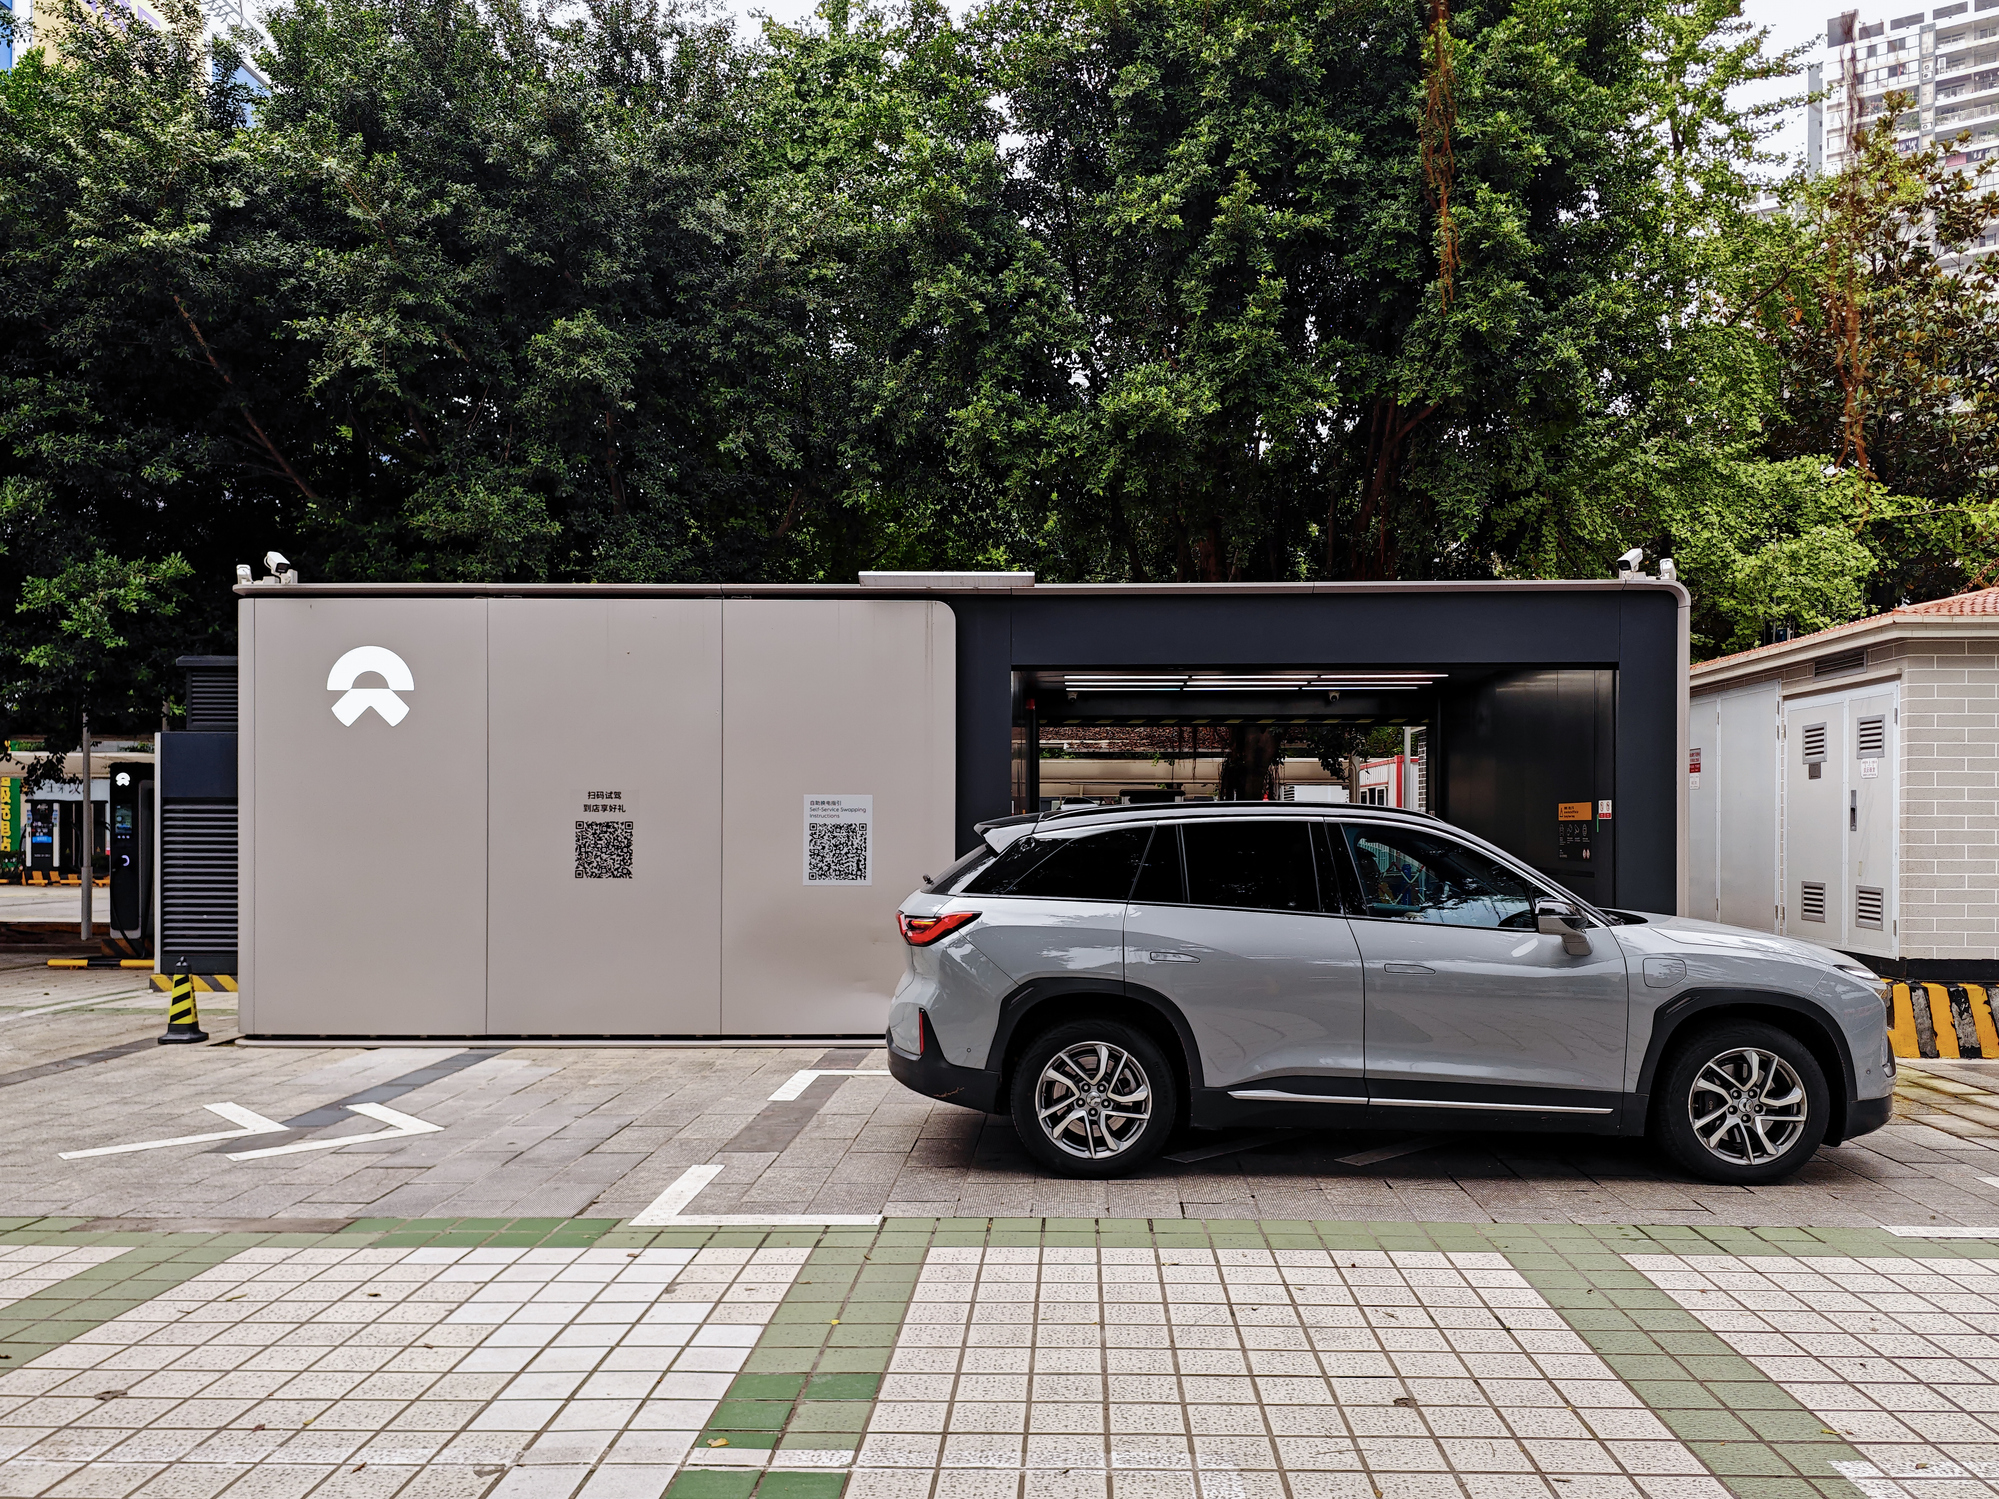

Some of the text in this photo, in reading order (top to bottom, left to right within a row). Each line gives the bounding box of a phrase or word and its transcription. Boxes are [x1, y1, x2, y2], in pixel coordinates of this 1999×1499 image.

[587, 791, 622, 800] 扫码试驾
[583, 804, 627, 813] 到店享好礼
